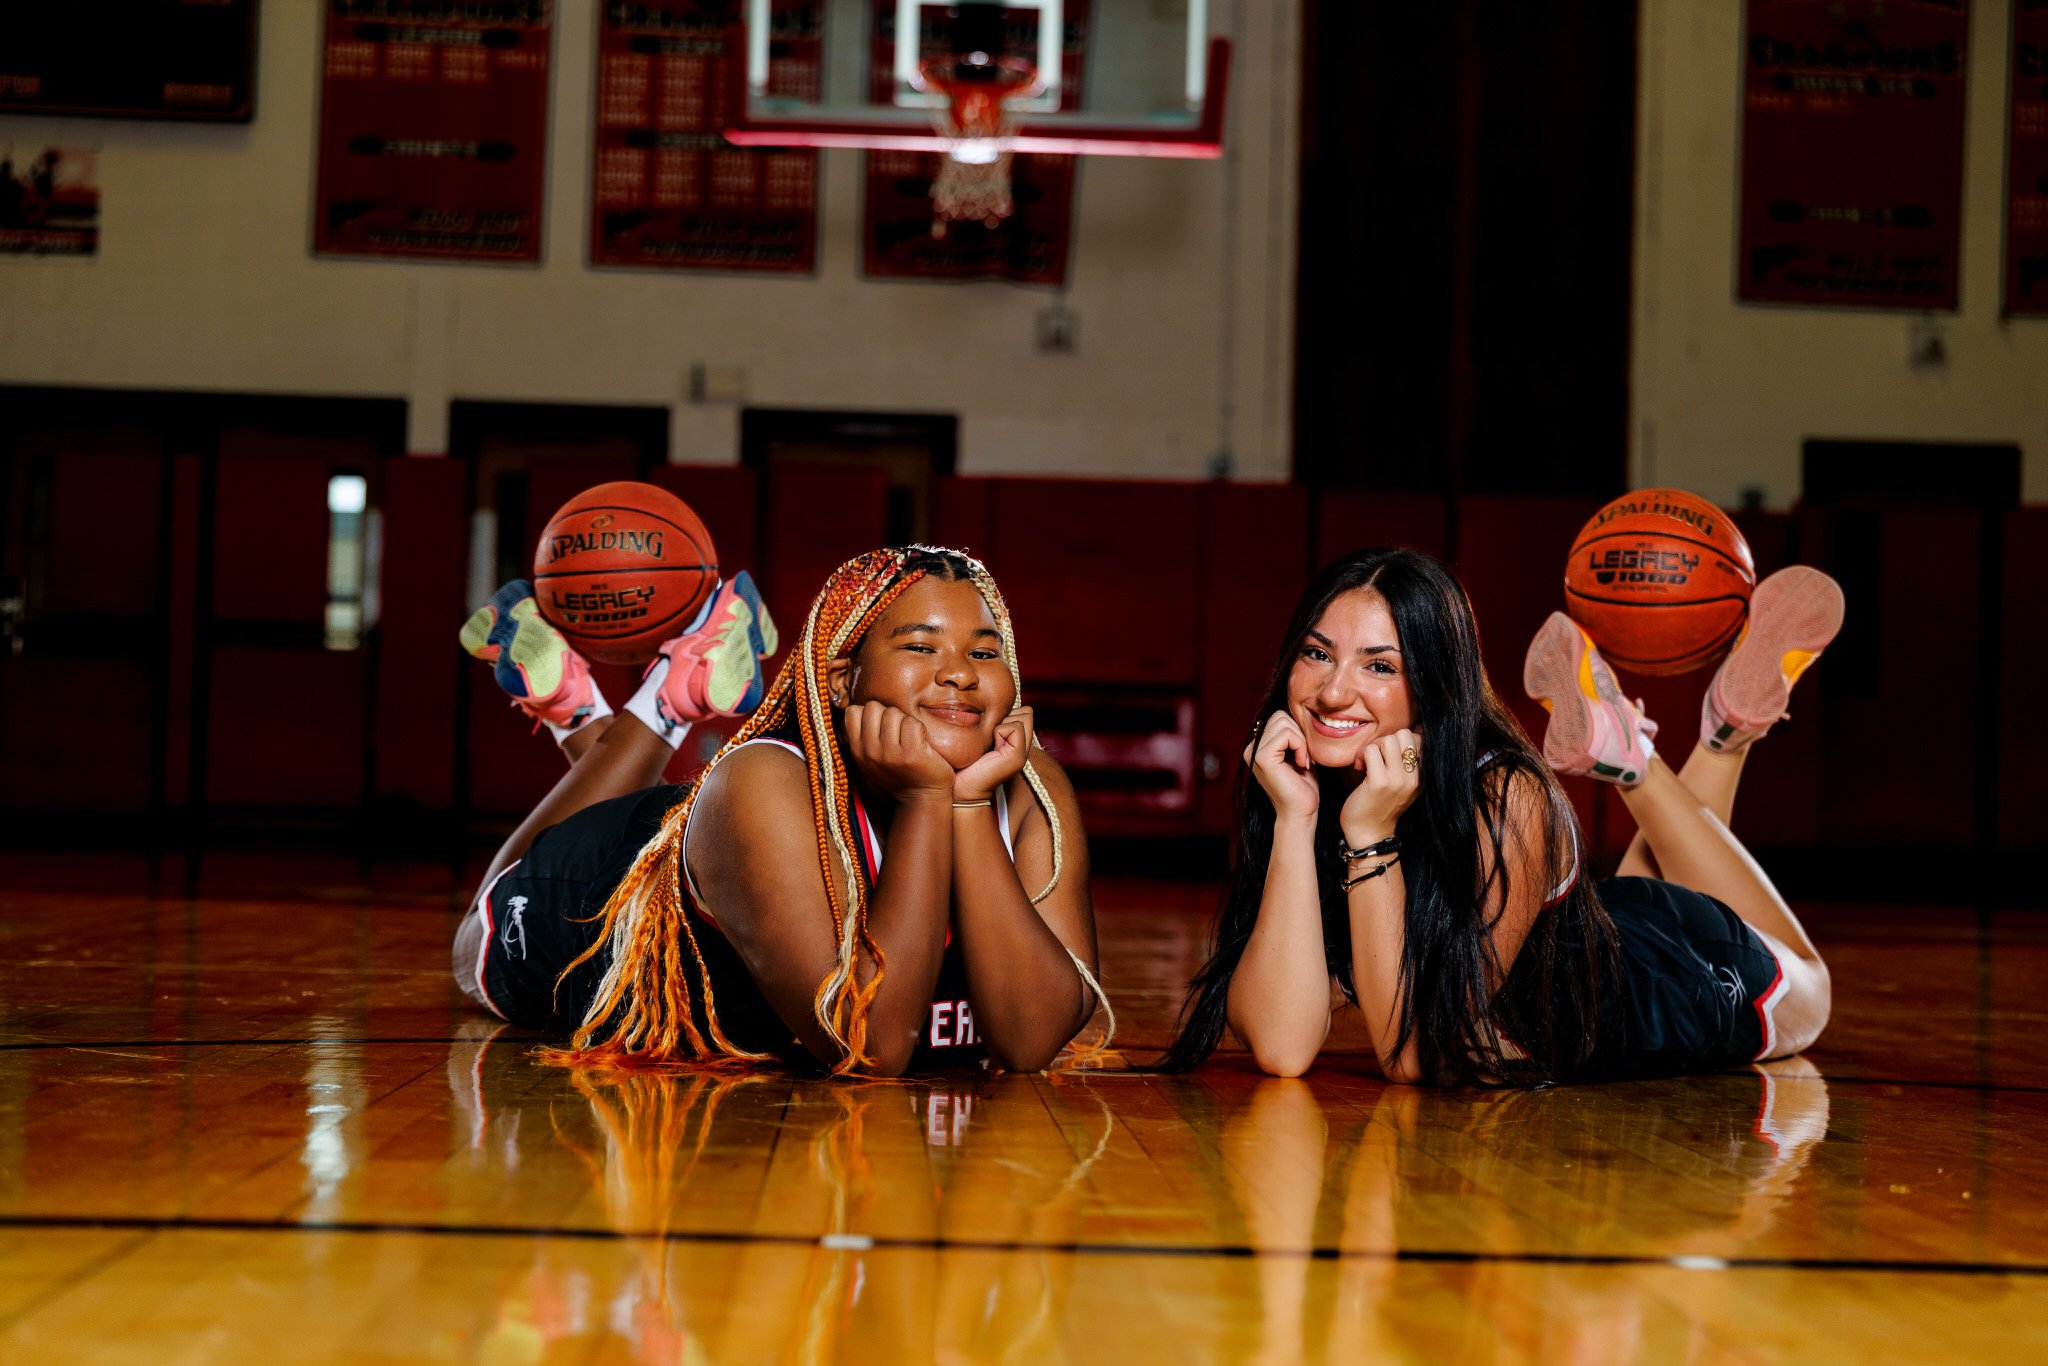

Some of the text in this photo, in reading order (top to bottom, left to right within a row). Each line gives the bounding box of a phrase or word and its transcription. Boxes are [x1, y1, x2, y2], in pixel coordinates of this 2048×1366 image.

[1594, 502, 1714, 536] SPALDING
[549, 530, 664, 564] SPALDING
[1590, 550, 1699, 572] LEGACY
[1619, 571, 1687, 585] 1000
[552, 586, 655, 609] LEGACY
[584, 608, 648, 622] 1000
